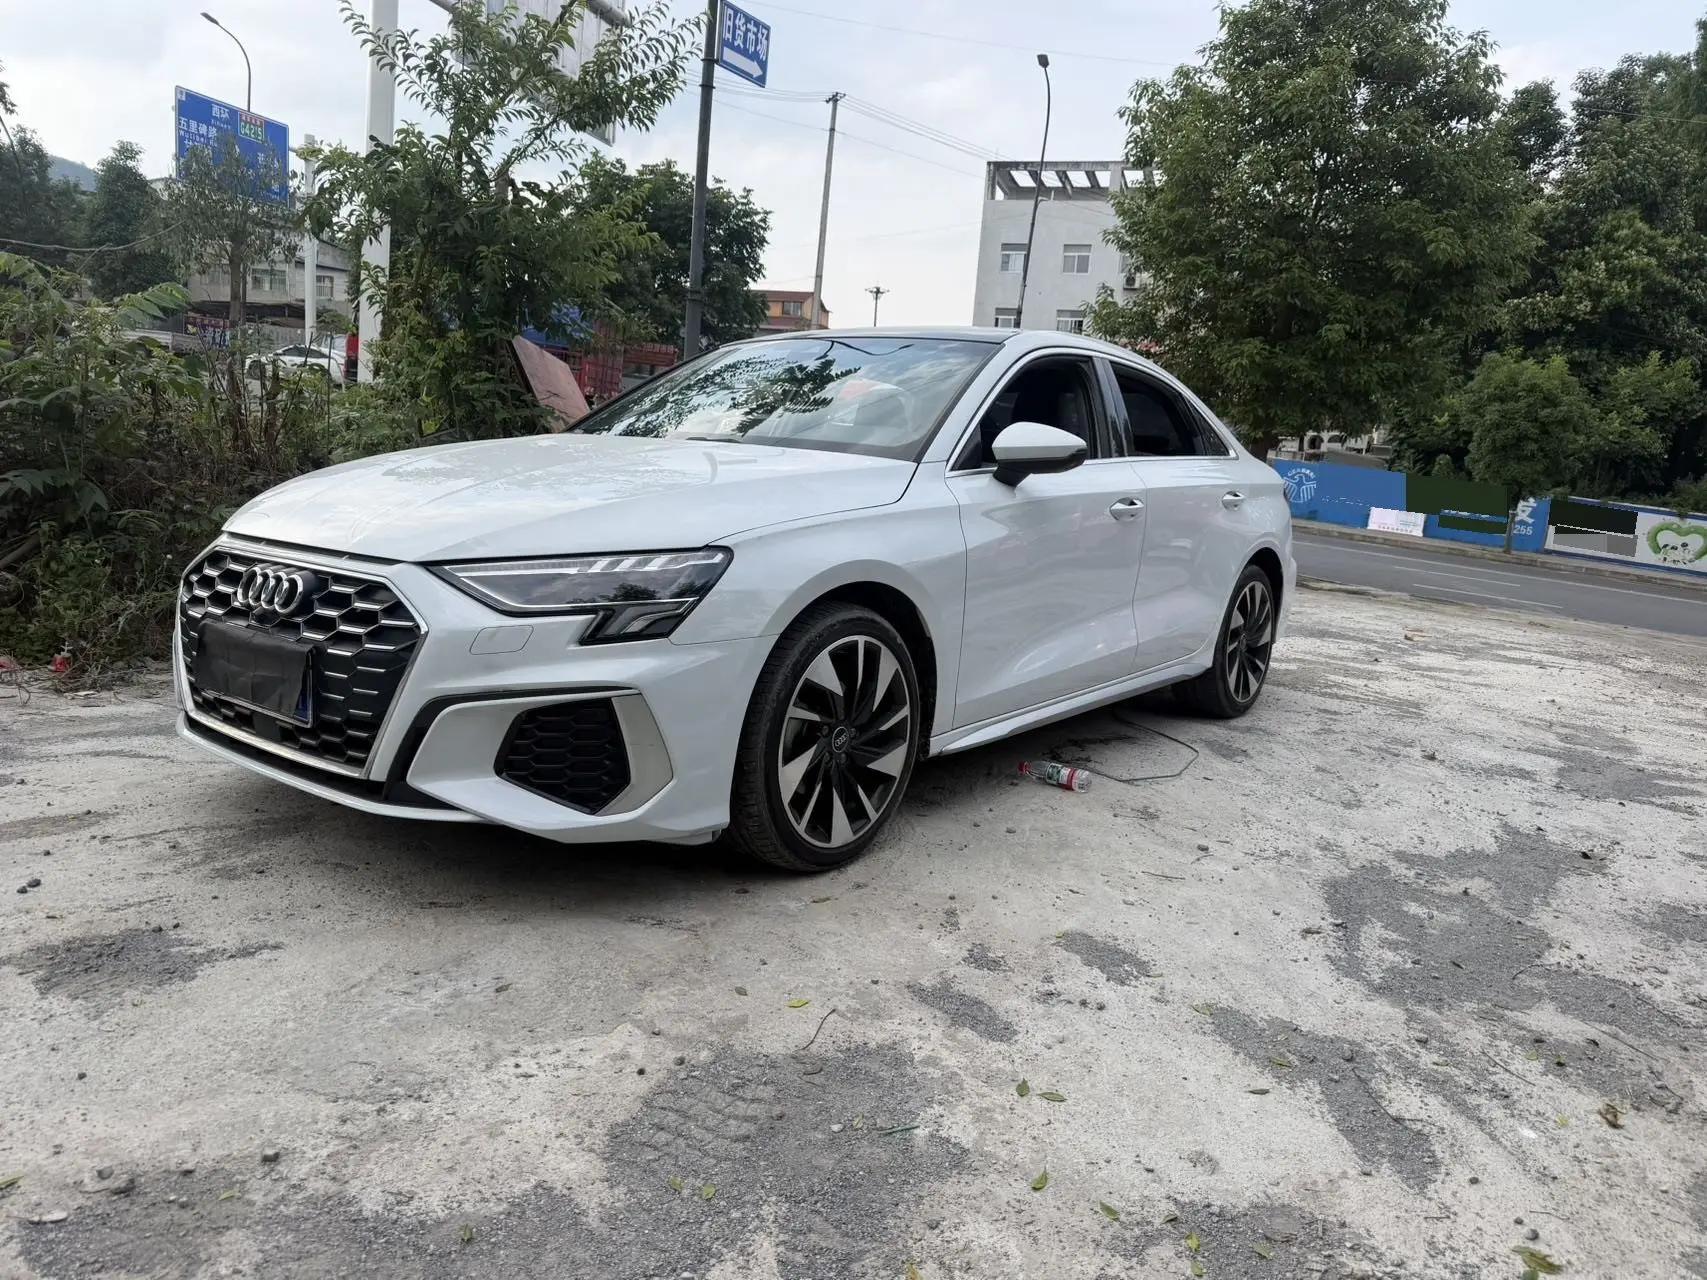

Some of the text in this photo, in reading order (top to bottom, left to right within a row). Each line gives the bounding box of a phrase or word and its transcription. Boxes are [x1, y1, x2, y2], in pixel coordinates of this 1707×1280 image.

[723, 5, 768, 61] 旧货市场
[179, 116, 217, 138] 五里碑路
